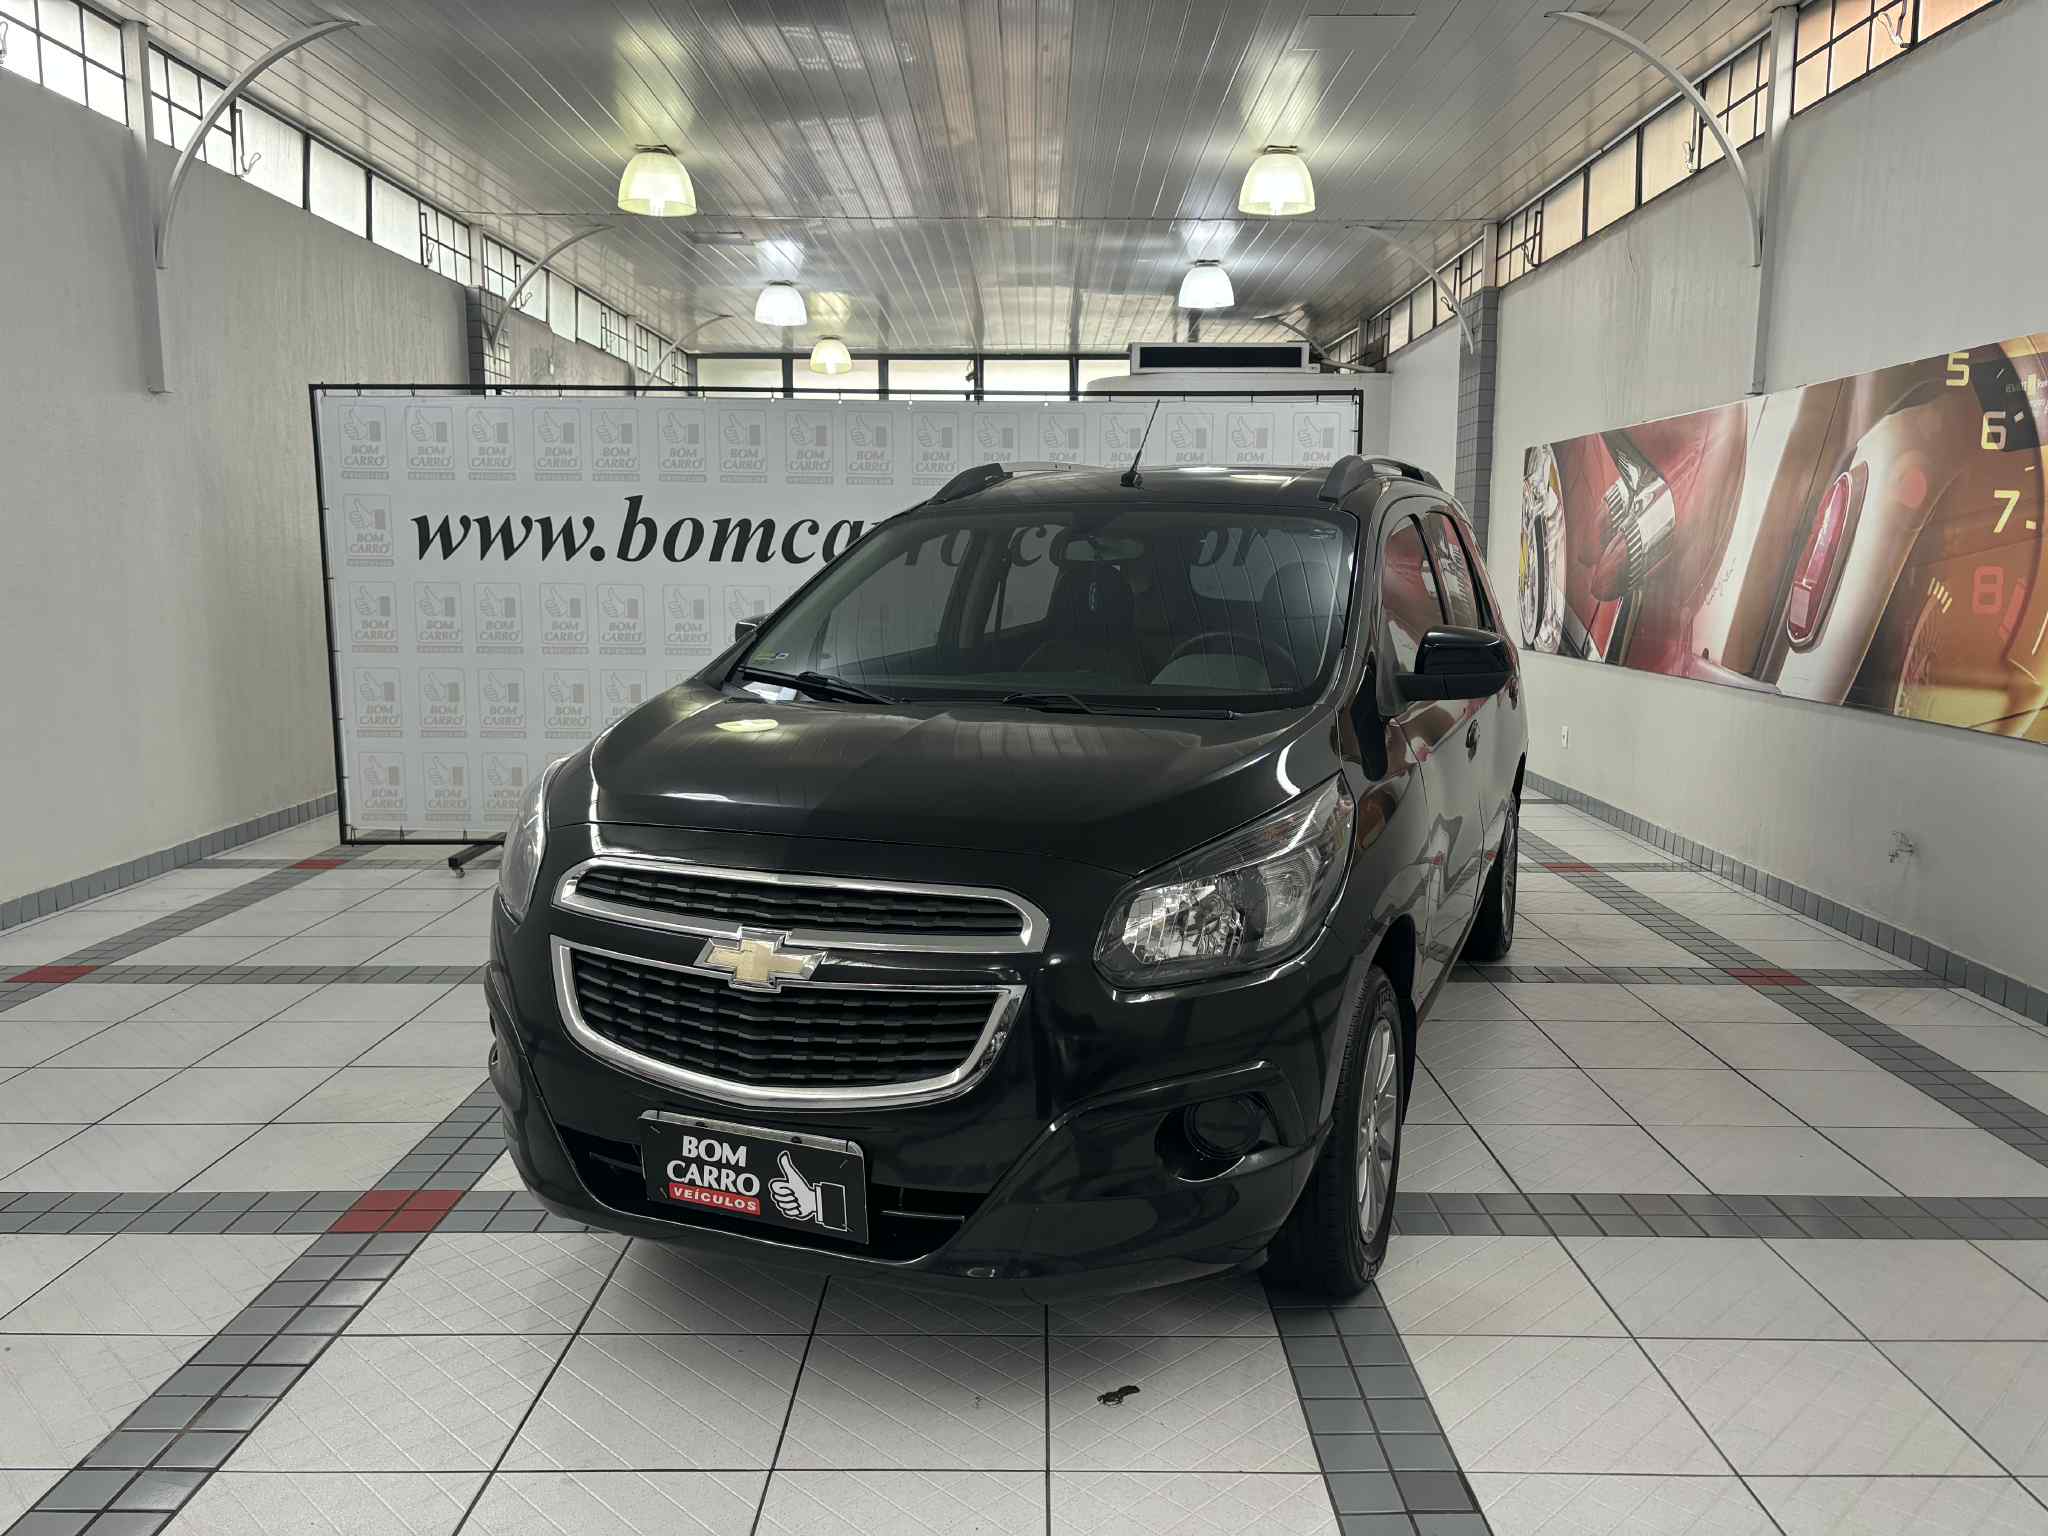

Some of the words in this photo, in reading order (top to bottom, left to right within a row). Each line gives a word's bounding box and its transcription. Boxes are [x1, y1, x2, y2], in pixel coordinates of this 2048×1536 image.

[1946, 352, 1970, 386] 5
[1981, 411, 2007, 450] 6
[351, 445, 379, 455] BOM
[417, 445, 446, 456] BOM
[479, 447, 506, 457] BOM
[544, 447, 572, 457] BOM
[602, 447, 630, 457] BOM
[343, 455, 384, 466] CARRO
[410, 456, 450, 467] CARRO
[472, 456, 511, 468] CARRO
[537, 457, 577, 468] CARRO
[595, 457, 636, 469] CARRO
[662, 459, 702, 470] CARRO
[723, 459, 763, 470] CARRO
[789, 460, 830, 471] CARRO
[849, 461, 890, 472] CARRO
[915, 462, 954, 473] CARRO
[1993, 489, 2020, 533] 7
[410, 494, 1270, 567] www.bomcao.cobr
[361, 620, 389, 630] BOM
[426, 620, 454, 630] BOM
[486, 621, 514, 630] BOM
[552, 622, 579, 631] BOM
[609, 622, 636, 632] BOM
[675, 623, 702, 632] BOM
[682, 1135, 747, 1168] BOM
[666, 1160, 761, 1197] CARRO
[673, 1186, 758, 1213] VEÍCULOS
